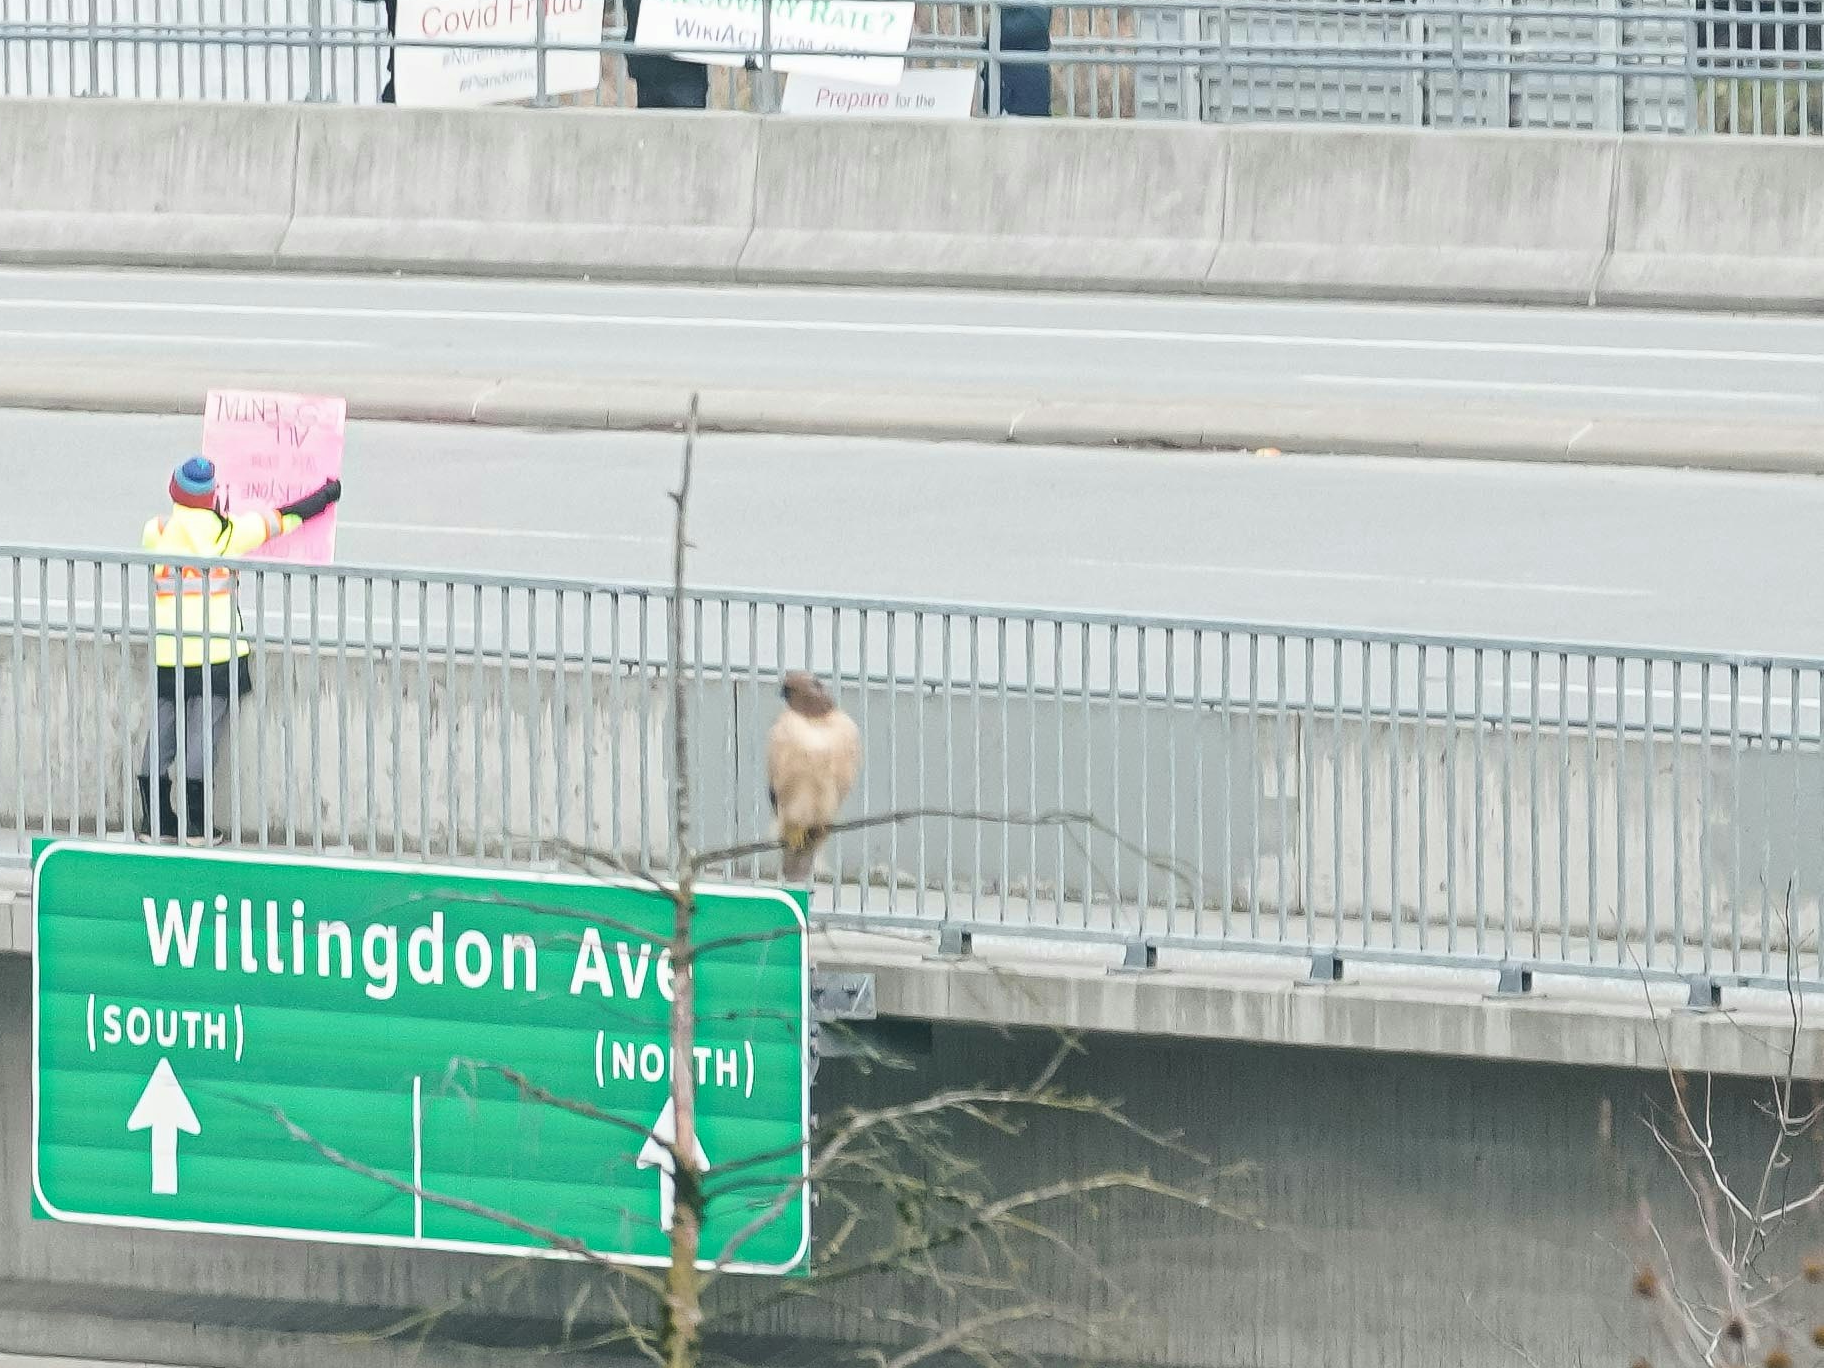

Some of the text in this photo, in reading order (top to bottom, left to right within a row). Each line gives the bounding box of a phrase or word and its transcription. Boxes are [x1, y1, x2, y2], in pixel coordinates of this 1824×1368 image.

[815, 87, 890, 114] Prepare
[141, 893, 695, 1003] Willingdon Ave
[85, 992, 245, 1064] (SOUTH)
